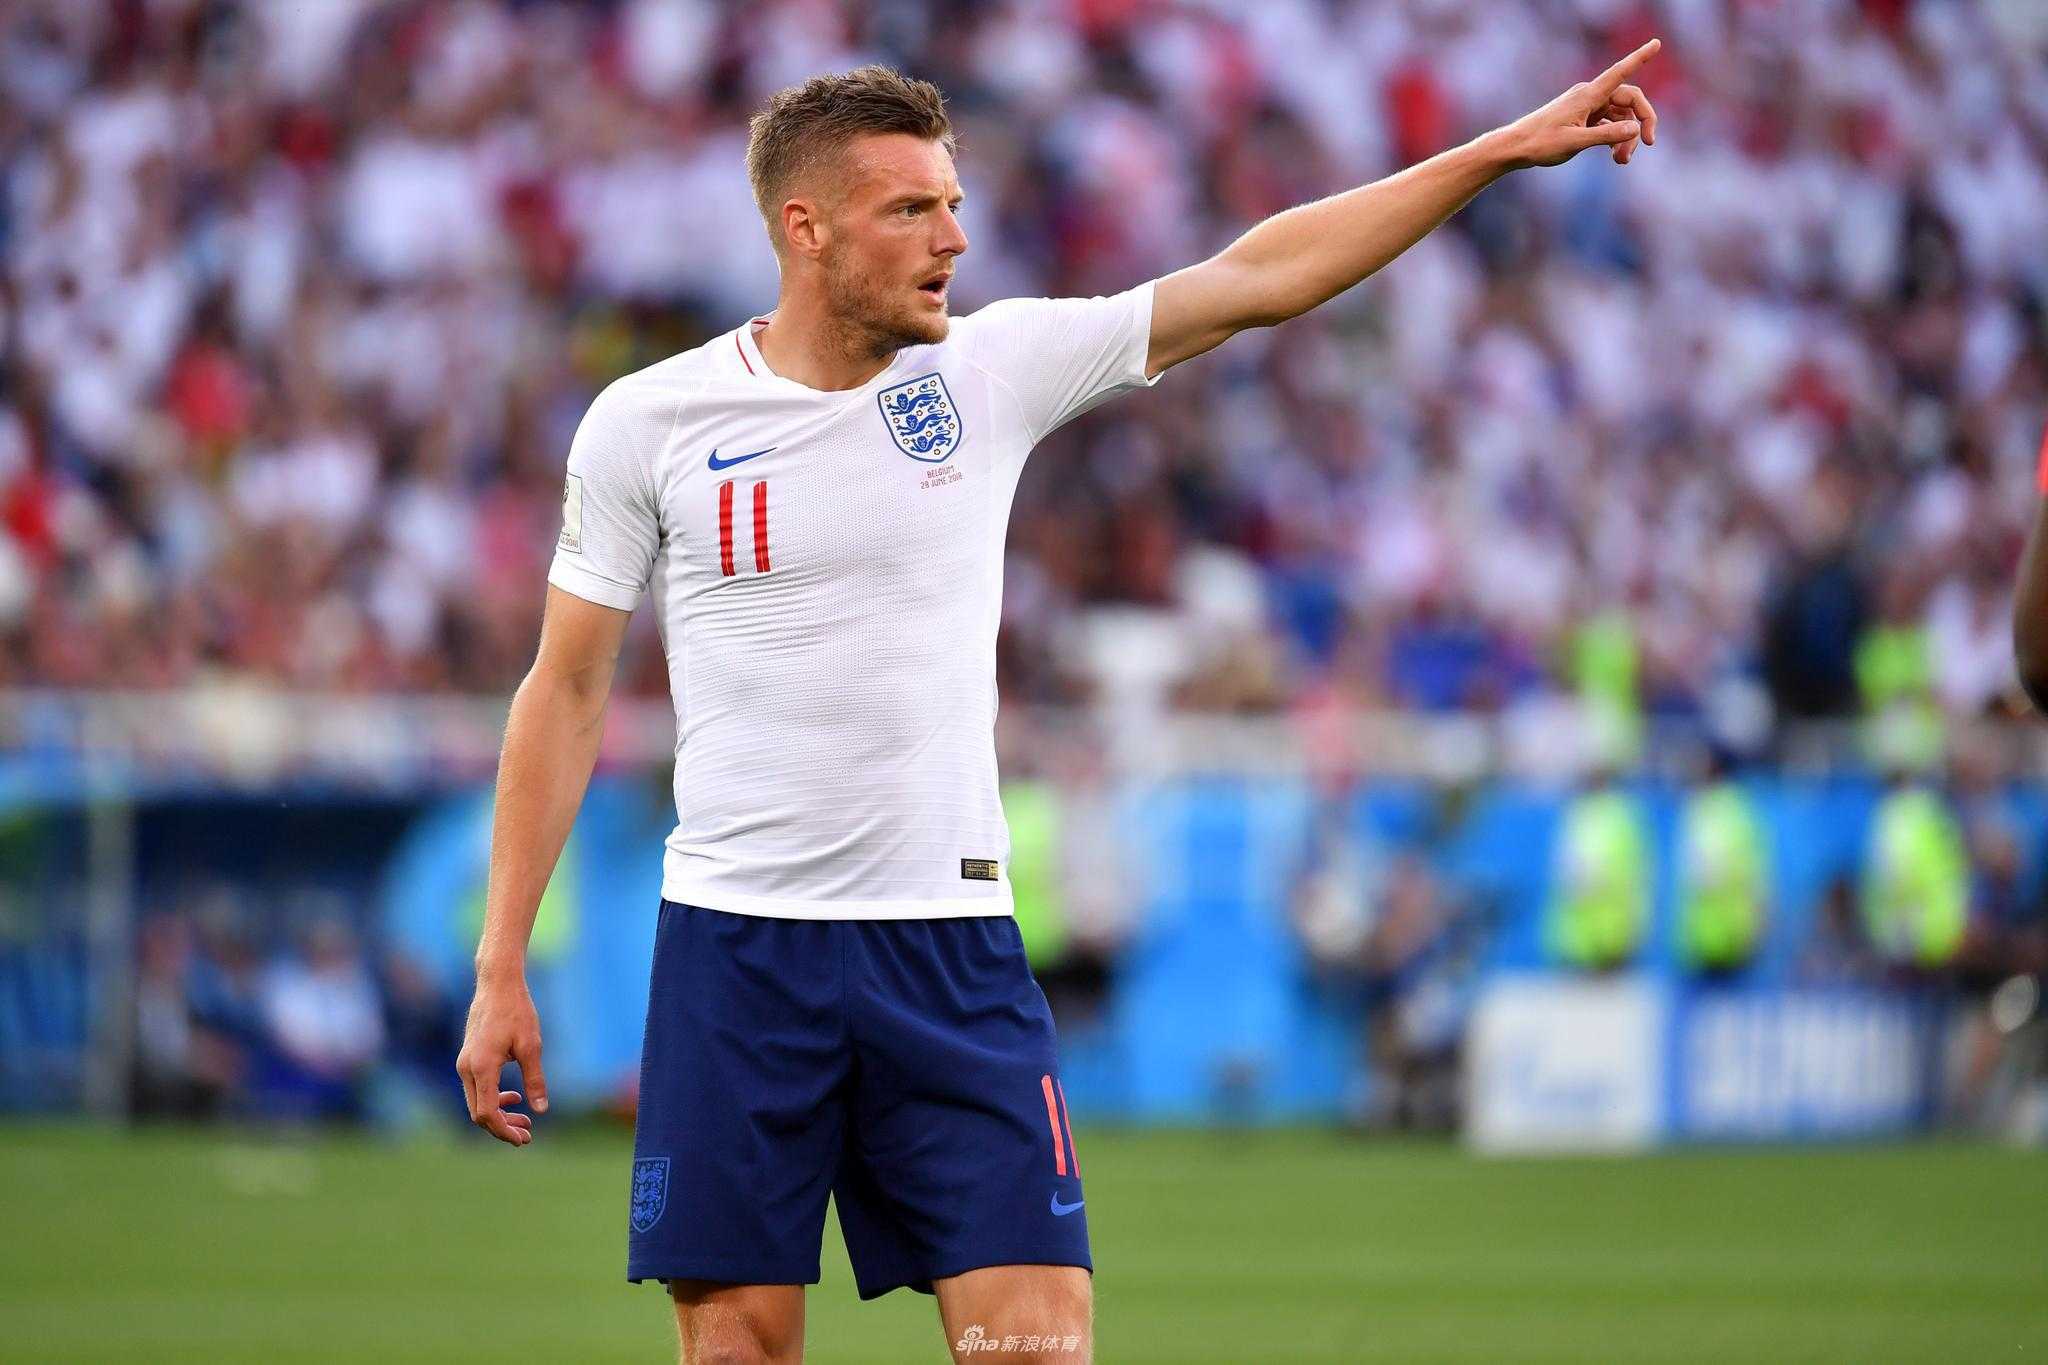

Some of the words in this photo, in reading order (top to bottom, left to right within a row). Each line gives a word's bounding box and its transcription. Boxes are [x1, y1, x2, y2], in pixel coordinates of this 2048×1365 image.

[927, 465, 955, 478] BELGIUM
[931, 477, 948, 487] JUNE
[719, 481, 771, 576] 11
